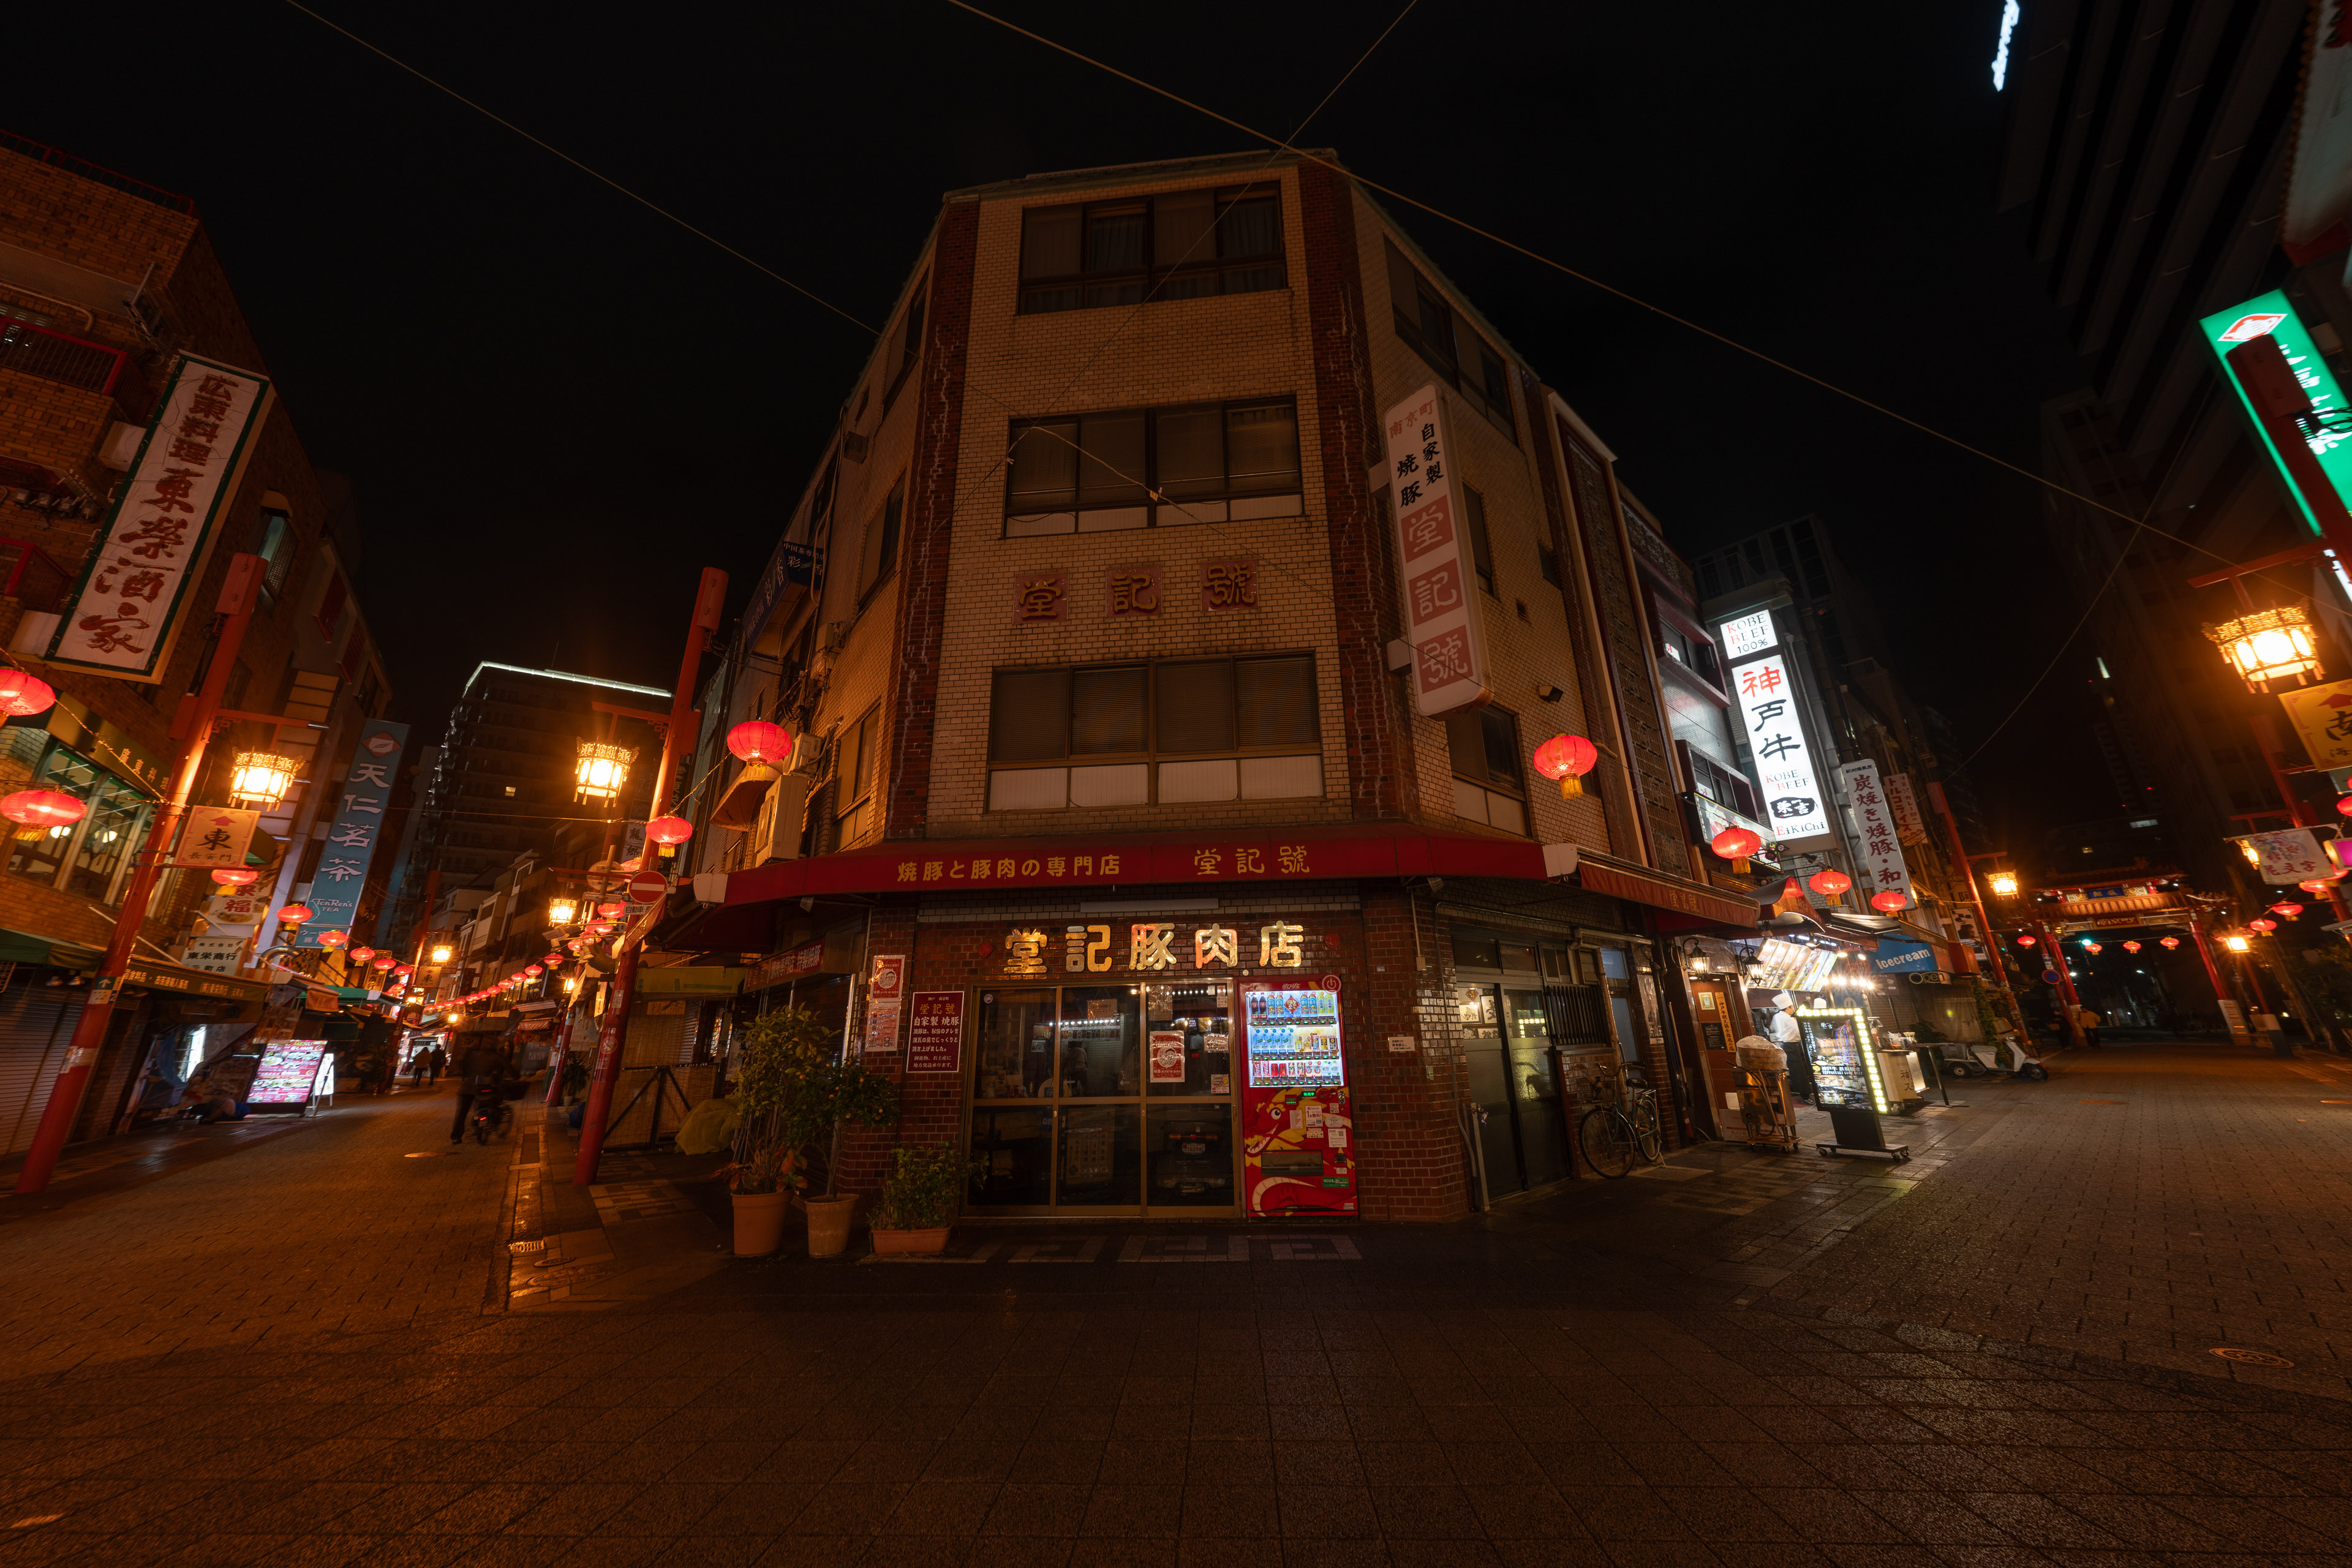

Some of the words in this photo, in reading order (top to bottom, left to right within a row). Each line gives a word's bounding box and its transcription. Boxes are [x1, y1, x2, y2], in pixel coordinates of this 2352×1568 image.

[1388, 398, 1434, 439] 南京町
[1421, 423, 1444, 486] 自家製
[1396, 454, 1423, 508] 焼豚
[1019, 562, 1256, 619] 堂記號
[1408, 505, 1468, 685] 堂記號
[1727, 613, 1766, 633] KOBE
[1731, 625, 1768, 644] BEEF
[1737, 638, 1768, 654] 100%
[1742, 666, 1801, 762] 神戸牛
[1766, 769, 1798, 783] KOBE
[1777, 777, 1809, 791] BEEF
[320, 763, 390, 882] 天仁茗茶
[1776, 822, 1825, 836] EiKiChi
[196, 828, 232, 851] 東
[188, 851, 232, 862] 長安門
[1194, 845, 1311, 875] 堂記號
[897, 854, 1121, 882] 焼豚と豚肉の専門店
[186, 952, 237, 960] 東栄商行
[1003, 920, 1304, 975] 堂記豚肉店
[1875, 948, 1931, 970] Icecream
[1909, 971, 1946, 985] Open
[920, 1003, 955, 1014] 堂記號
[914, 1016, 938, 1027] 自家製
[941, 1016, 960, 1026] 焼豚
